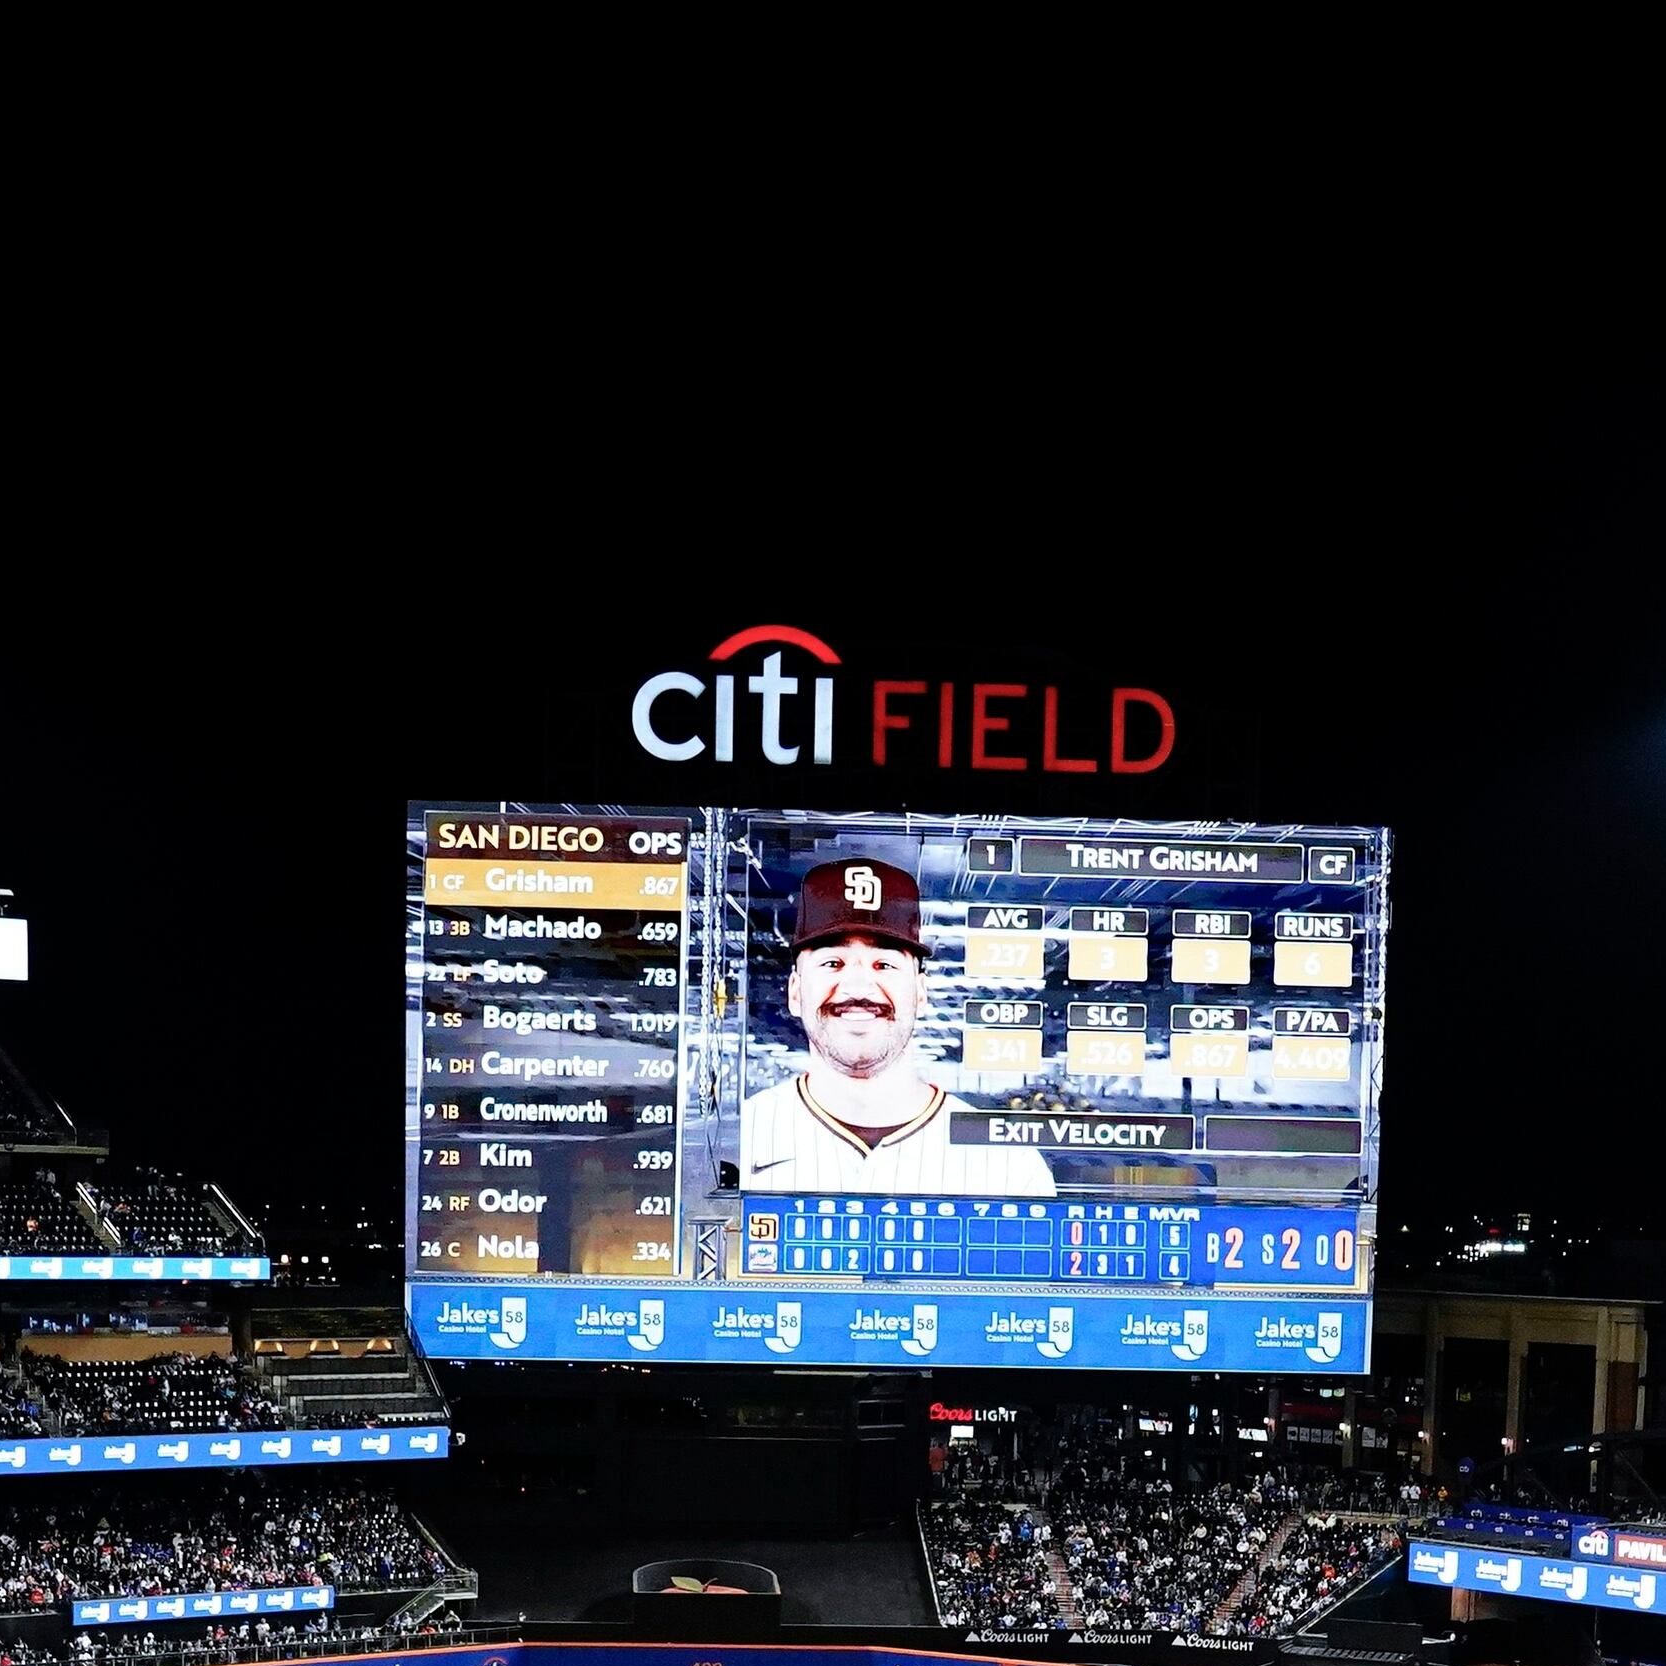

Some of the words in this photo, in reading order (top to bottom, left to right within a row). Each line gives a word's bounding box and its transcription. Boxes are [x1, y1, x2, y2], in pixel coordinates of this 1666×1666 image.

[632, 631, 840, 766] citi
[873, 680, 1175, 774] FIELD
[439, 824, 499, 850] SAN
[509, 825, 603, 852] DIEGO
[629, 832, 682, 854] OPS
[1066, 844, 1143, 870] TRENT
[1149, 846, 1257, 872] GRISHAM
[1319, 855, 1347, 876] CF
[430, 874, 435, 889] 1
[443, 875, 464, 890] CF
[486, 868, 593, 893] Grisham
[639, 877, 679, 895] .867
[429, 921, 443, 935] 13
[450, 921, 470, 936] 3B
[484, 915, 601, 939] Machado
[637, 923, 678, 941] .659
[983, 909, 1028, 928] AVG
[1093, 912, 1124, 931] HR
[1195, 915, 1230, 934] RBI
[1284, 917, 1343, 937] RUNS
[454, 968, 471, 982] LF
[483, 960, 545, 984] Soto
[639, 969, 676, 987] .783
[426, 1013, 435, 1027] 2
[443, 1014, 462, 1028] SS
[483, 1006, 596, 1035] Bogaerts
[631, 1015, 675, 1032] 1.019
[981, 1006, 1028, 1023] OBP
[1087, 1008, 1127, 1026] SLG
[1189, 1010, 1234, 1029] OPS
[1287, 1012, 1339, 1032] P/PA
[426, 1059, 442, 1073] 14
[450, 1060, 474, 1074] DH
[482, 1052, 609, 1080] Carpenter
[634, 1060, 674, 1078] .760
[424, 1104, 434, 1118] 9
[442, 1105, 459, 1119] 1B
[480, 1097, 607, 1123] Cronenworth
[637, 1105, 673, 1124] .681
[988, 1119, 1043, 1144] EXIT
[1049, 1120, 1165, 1146] VELOCITY
[423, 1151, 432, 1165] 7
[440, 1151, 460, 1165] 2B
[480, 1144, 532, 1167] Kim
[633, 1151, 673, 1170] .939
[422, 1196, 442, 1211] 24
[450, 1197, 470, 1211] RF
[478, 1189, 547, 1214] Odor
[636, 1197, 671, 1215] .621
[1150, 1208, 1200, 1221] MVR
[421, 1242, 441, 1257] 26
[448, 1243, 460, 1257] C
[478, 1235, 539, 1259] Nola
[633, 1243, 671, 1261] .334
[1208, 1233, 1219, 1263] B
[1224, 1227, 1243, 1268] 2
[1262, 1234, 1274, 1264] S
[1282, 1228, 1301, 1270] 2
[1335, 1229, 1353, 1271] 0
[437, 1302, 499, 1324] Jake's
[505, 1311, 523, 1323] 58
[930, 1403, 973, 1420] Coors
[975, 1407, 1017, 1422] LIGHT
[1579, 1533, 1609, 1556] citi
[981, 1630, 1017, 1643] Coors
[1018, 1633, 1049, 1643] LIGHT
[1084, 1630, 1119, 1644] Coors
[1121, 1634, 1152, 1645] LIGHT
[1187, 1633, 1221, 1649] Coors
[1222, 1640, 1254, 1651] LIGHT
